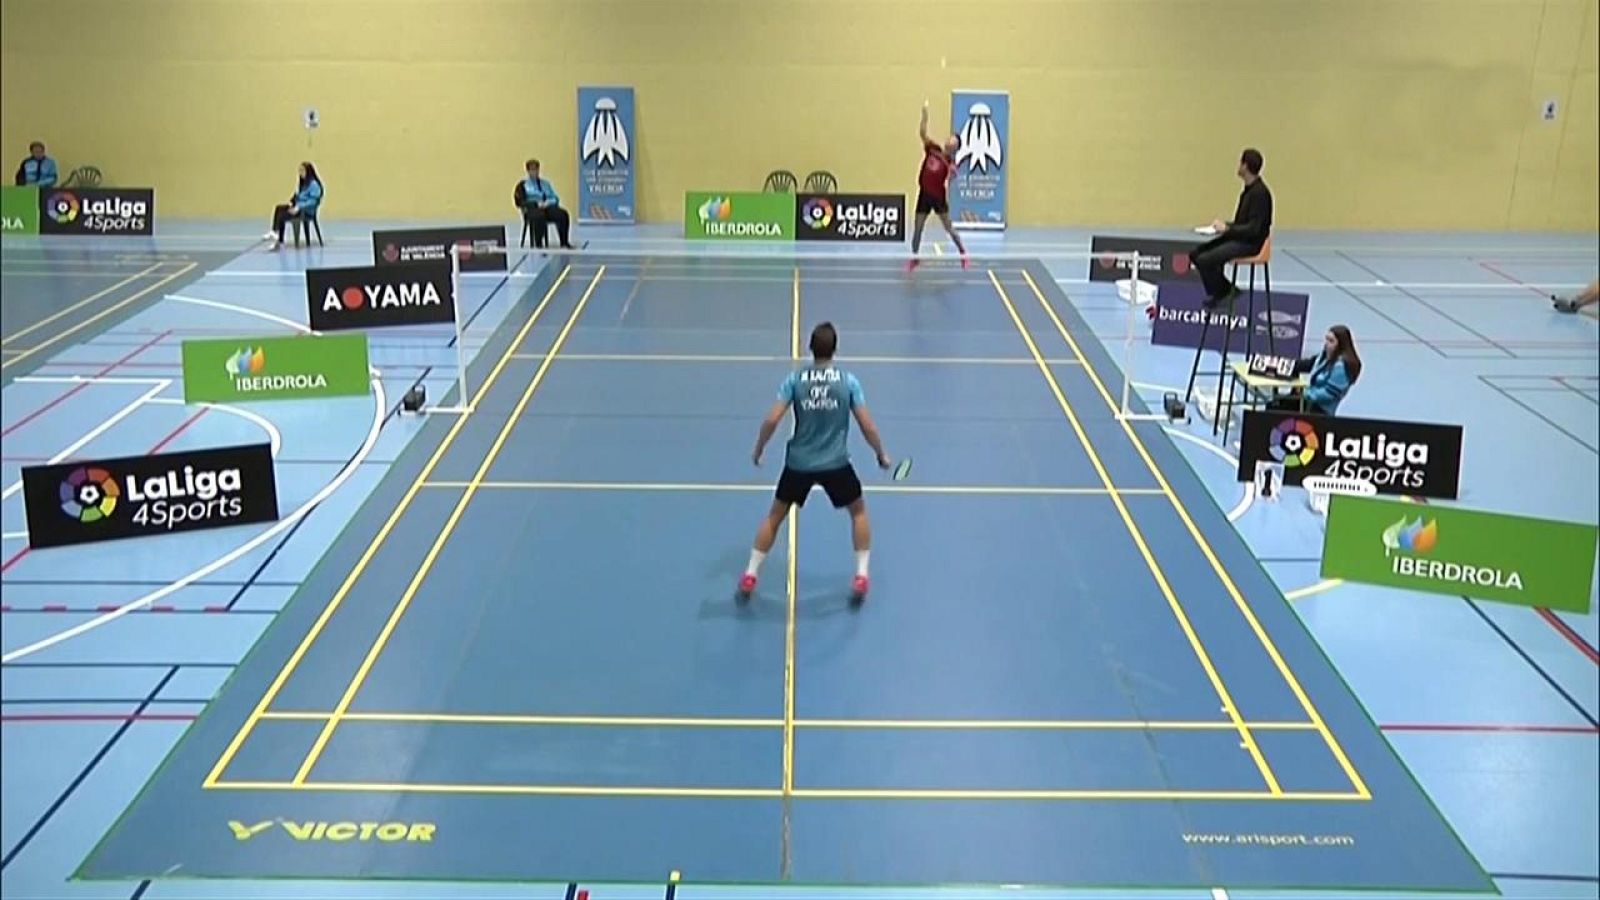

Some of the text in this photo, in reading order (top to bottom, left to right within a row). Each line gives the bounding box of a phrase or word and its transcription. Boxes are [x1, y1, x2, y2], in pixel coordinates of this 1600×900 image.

[83, 197, 146, 217] LaLiga
[836, 202, 898, 223] LaLiga
[84, 215, 145, 232] 4Sports
[705, 222, 782, 236] IBERDROLA
[838, 221, 897, 238] 4Sports
[236, 374, 327, 392] IBERDROLA
[1324, 432, 1429, 469] LaLiga
[126, 465, 242, 501] LaLiga
[1324, 459, 1426, 488] 4Sports
[132, 496, 243, 530] 4Sports
[1393, 556, 1524, 590] IBERDROLA
[282, 821, 436, 841] VICTOR
